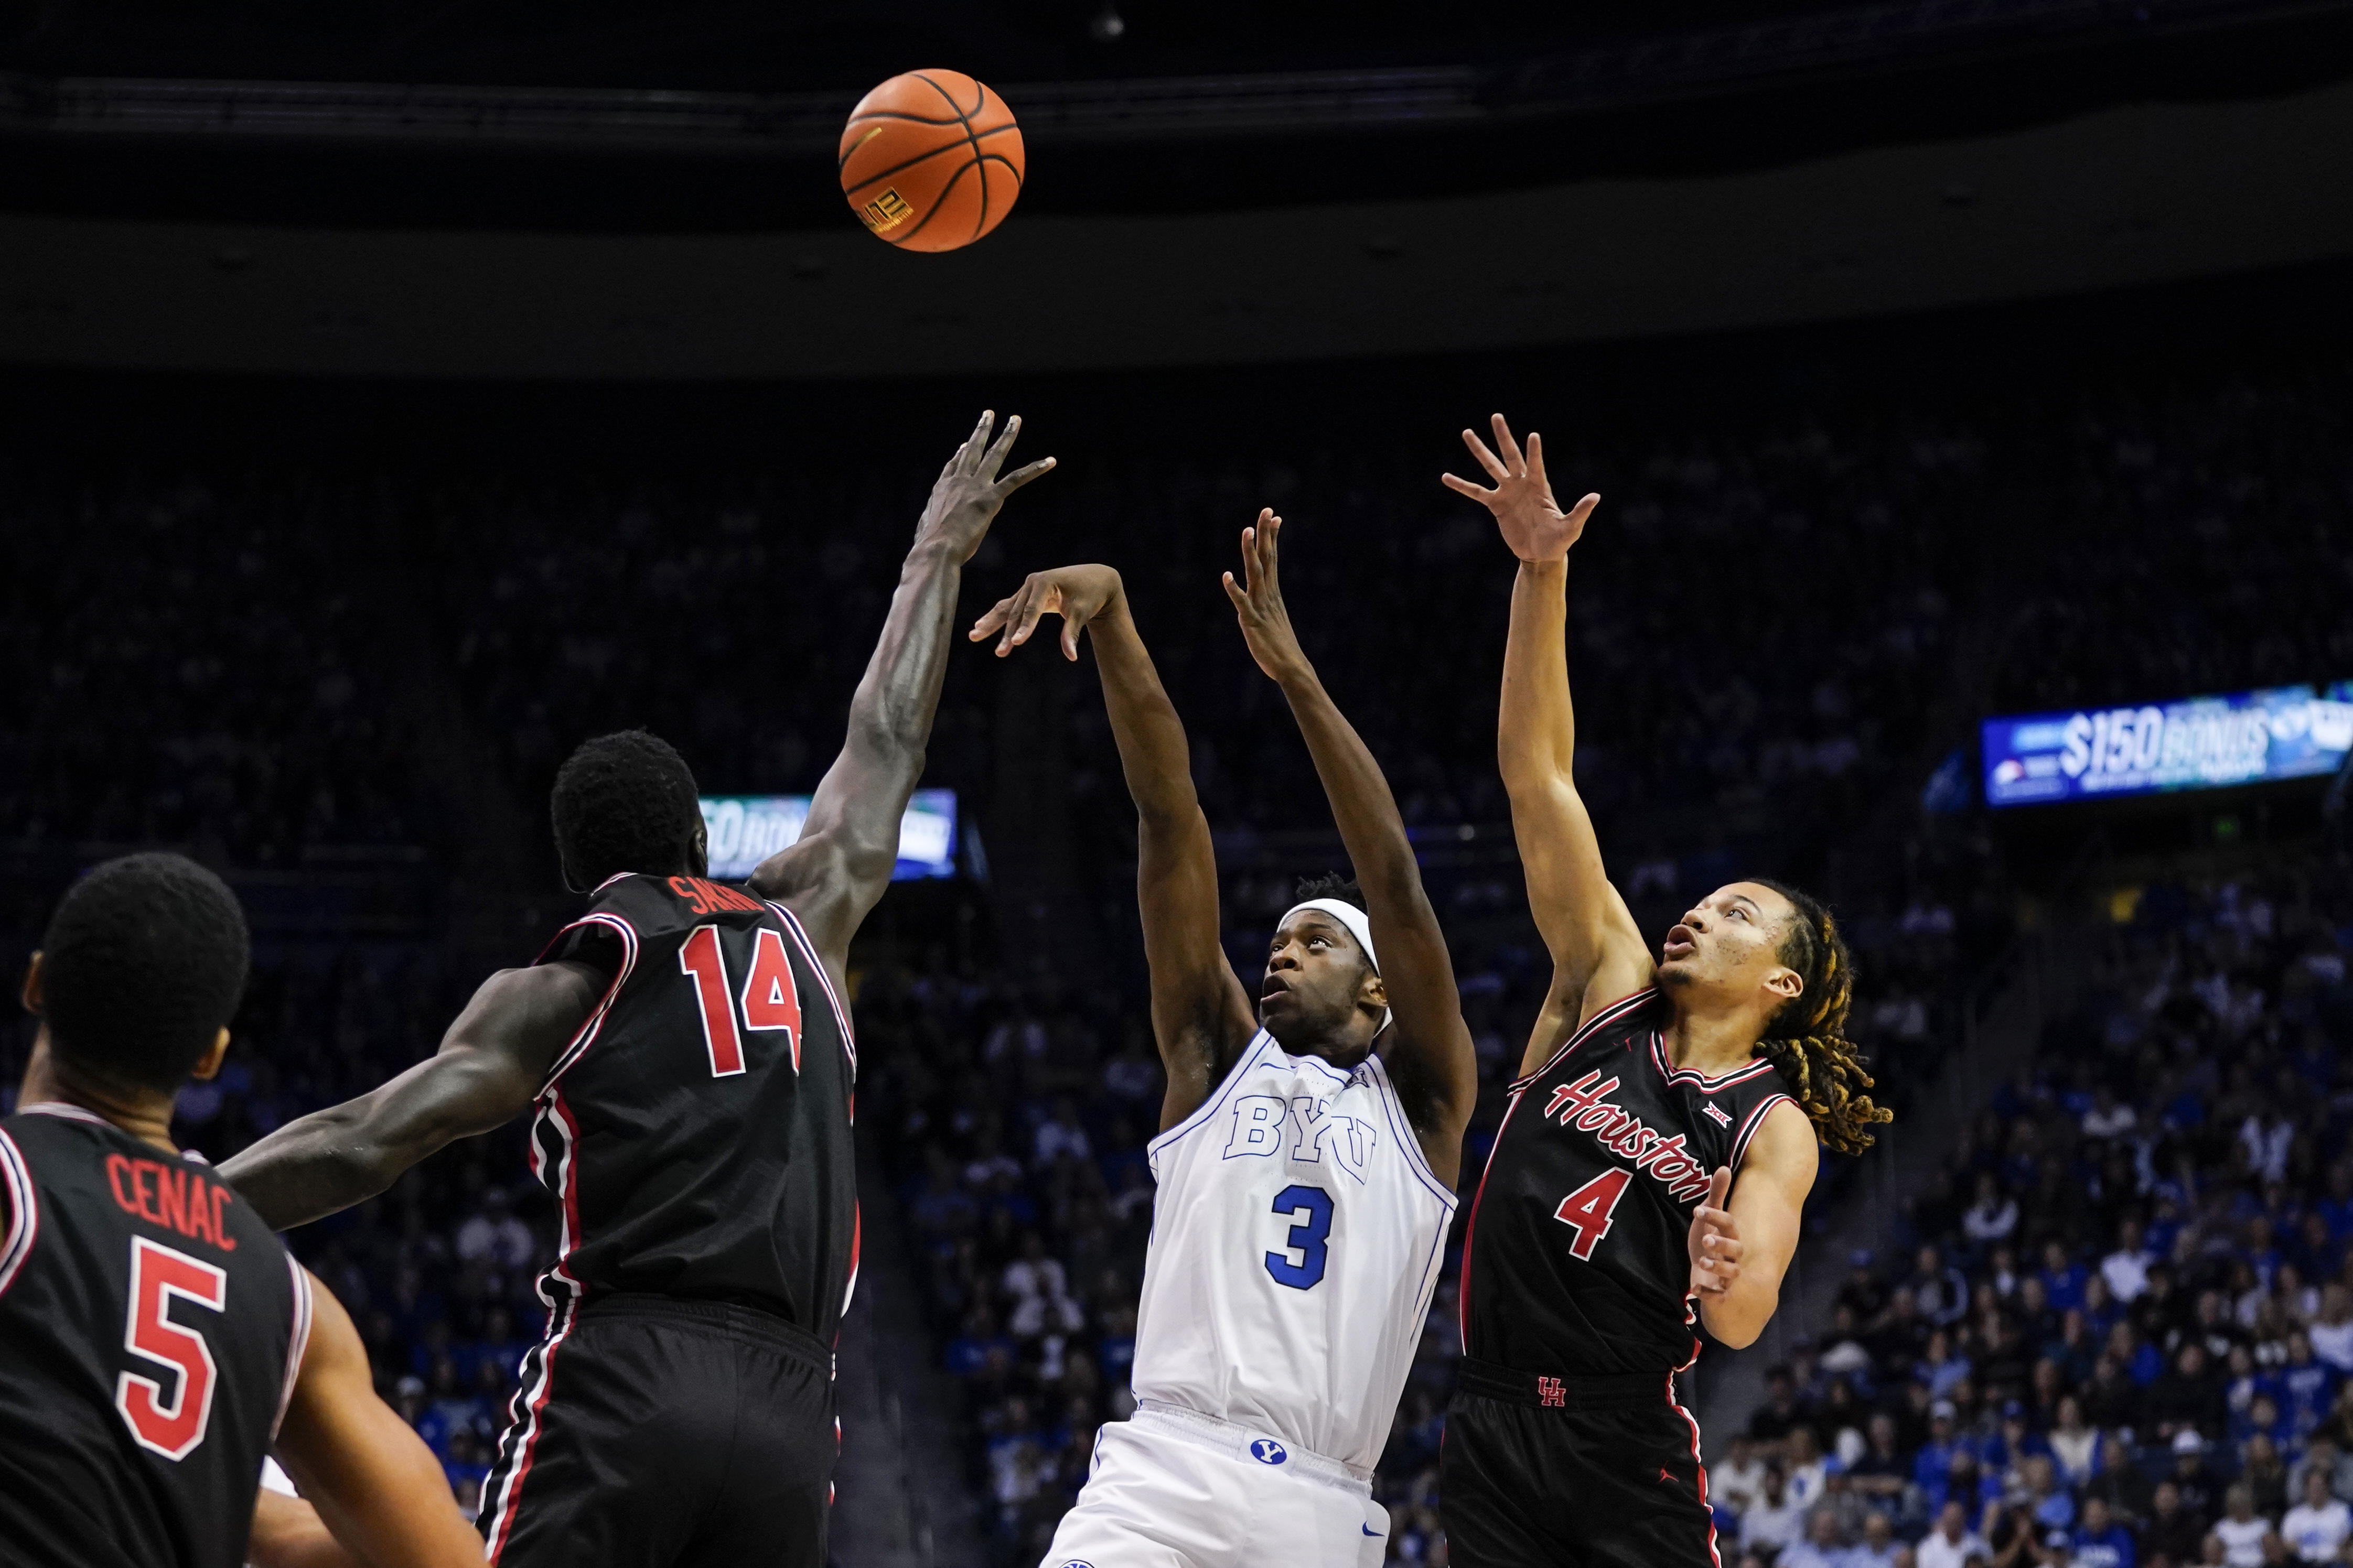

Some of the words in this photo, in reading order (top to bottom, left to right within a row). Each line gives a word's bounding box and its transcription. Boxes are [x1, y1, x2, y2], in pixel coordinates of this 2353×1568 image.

[2060, 706, 2164, 777] $150
[678, 924, 802, 1077] 14
[1222, 1095, 1376, 1185] BYU
[1544, 1068, 1713, 1203] Houston
[104, 1153, 238, 1252] CENAC
[1265, 1185, 1335, 1291] 3
[1553, 1166, 1634, 1262] 4
[115, 1235, 228, 1462] 5
